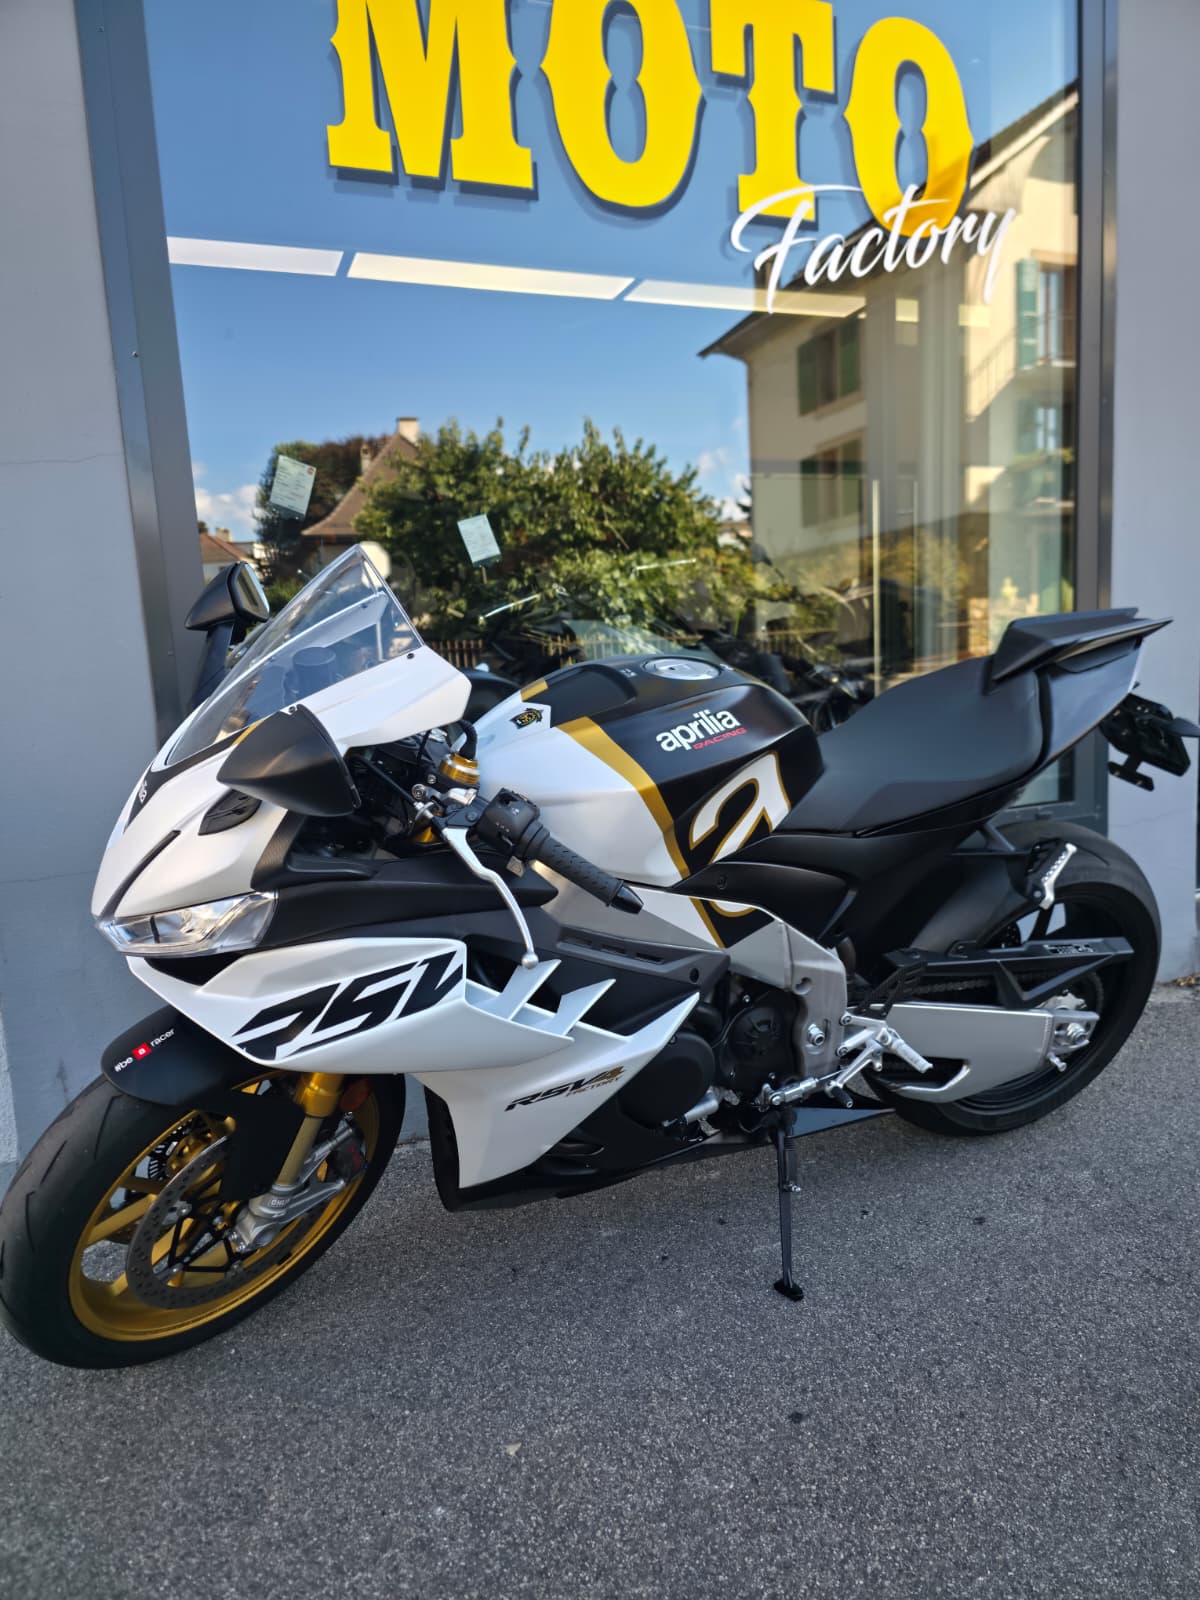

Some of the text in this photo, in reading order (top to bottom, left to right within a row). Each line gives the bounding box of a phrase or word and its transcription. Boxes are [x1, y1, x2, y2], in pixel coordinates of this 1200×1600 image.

[326, 0, 975, 239] MOTO
[730, 183, 1016, 314] Factory
[655, 709, 741, 752] aprilia
[150, 1028, 175, 1047] racer
